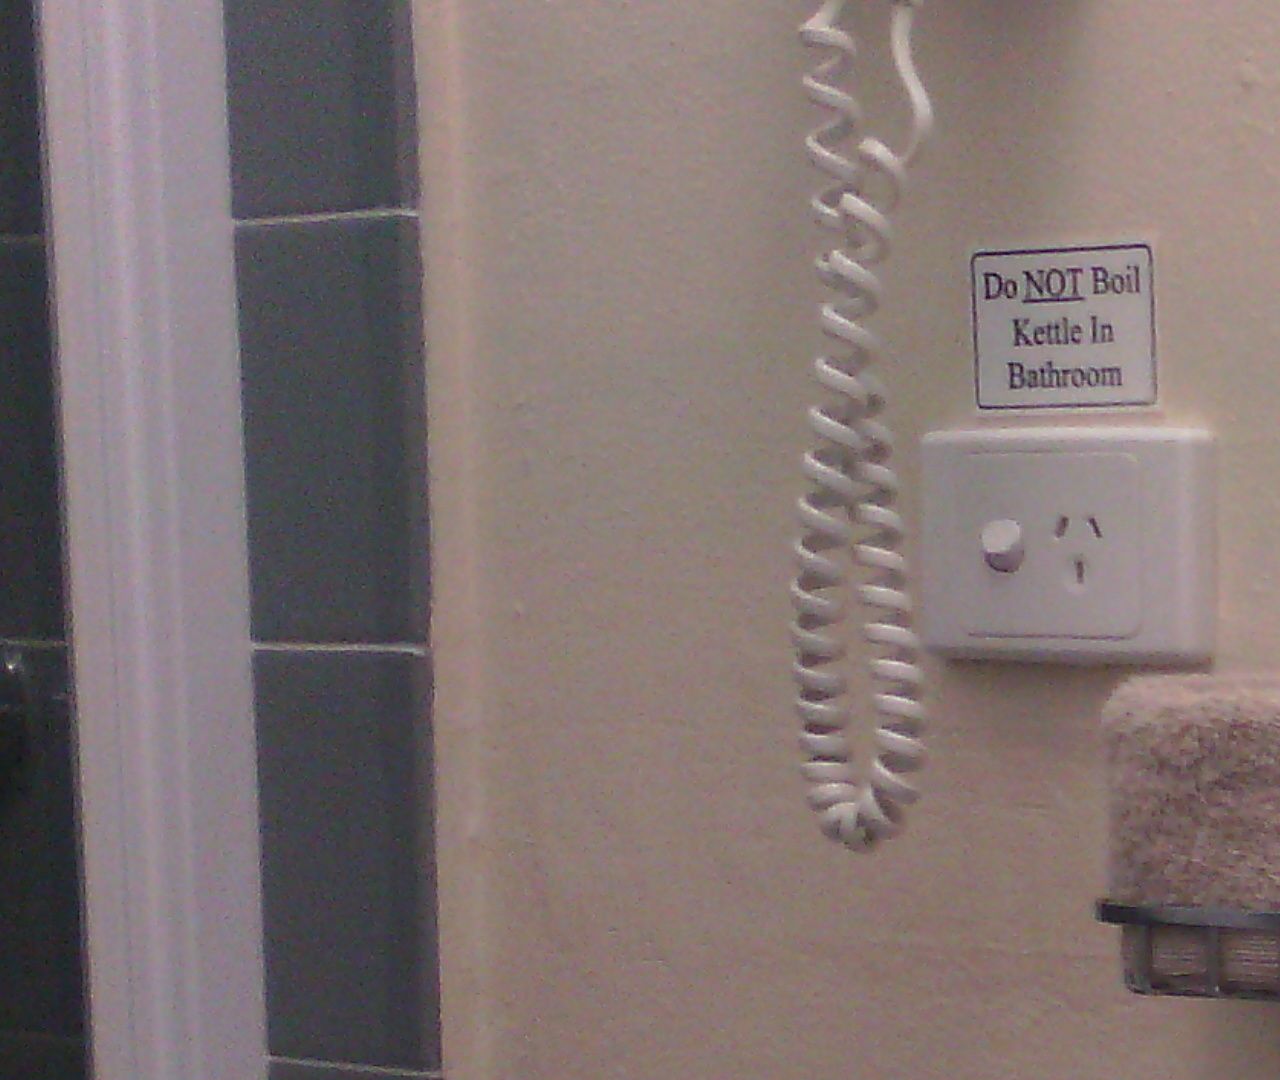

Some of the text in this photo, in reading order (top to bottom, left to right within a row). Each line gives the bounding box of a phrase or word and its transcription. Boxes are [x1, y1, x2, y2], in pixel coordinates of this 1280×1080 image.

[983, 265, 1140, 303] Do NOT Boil
[1013, 316, 1114, 346] Kettle In
[1008, 361, 1122, 389] Bathroom
